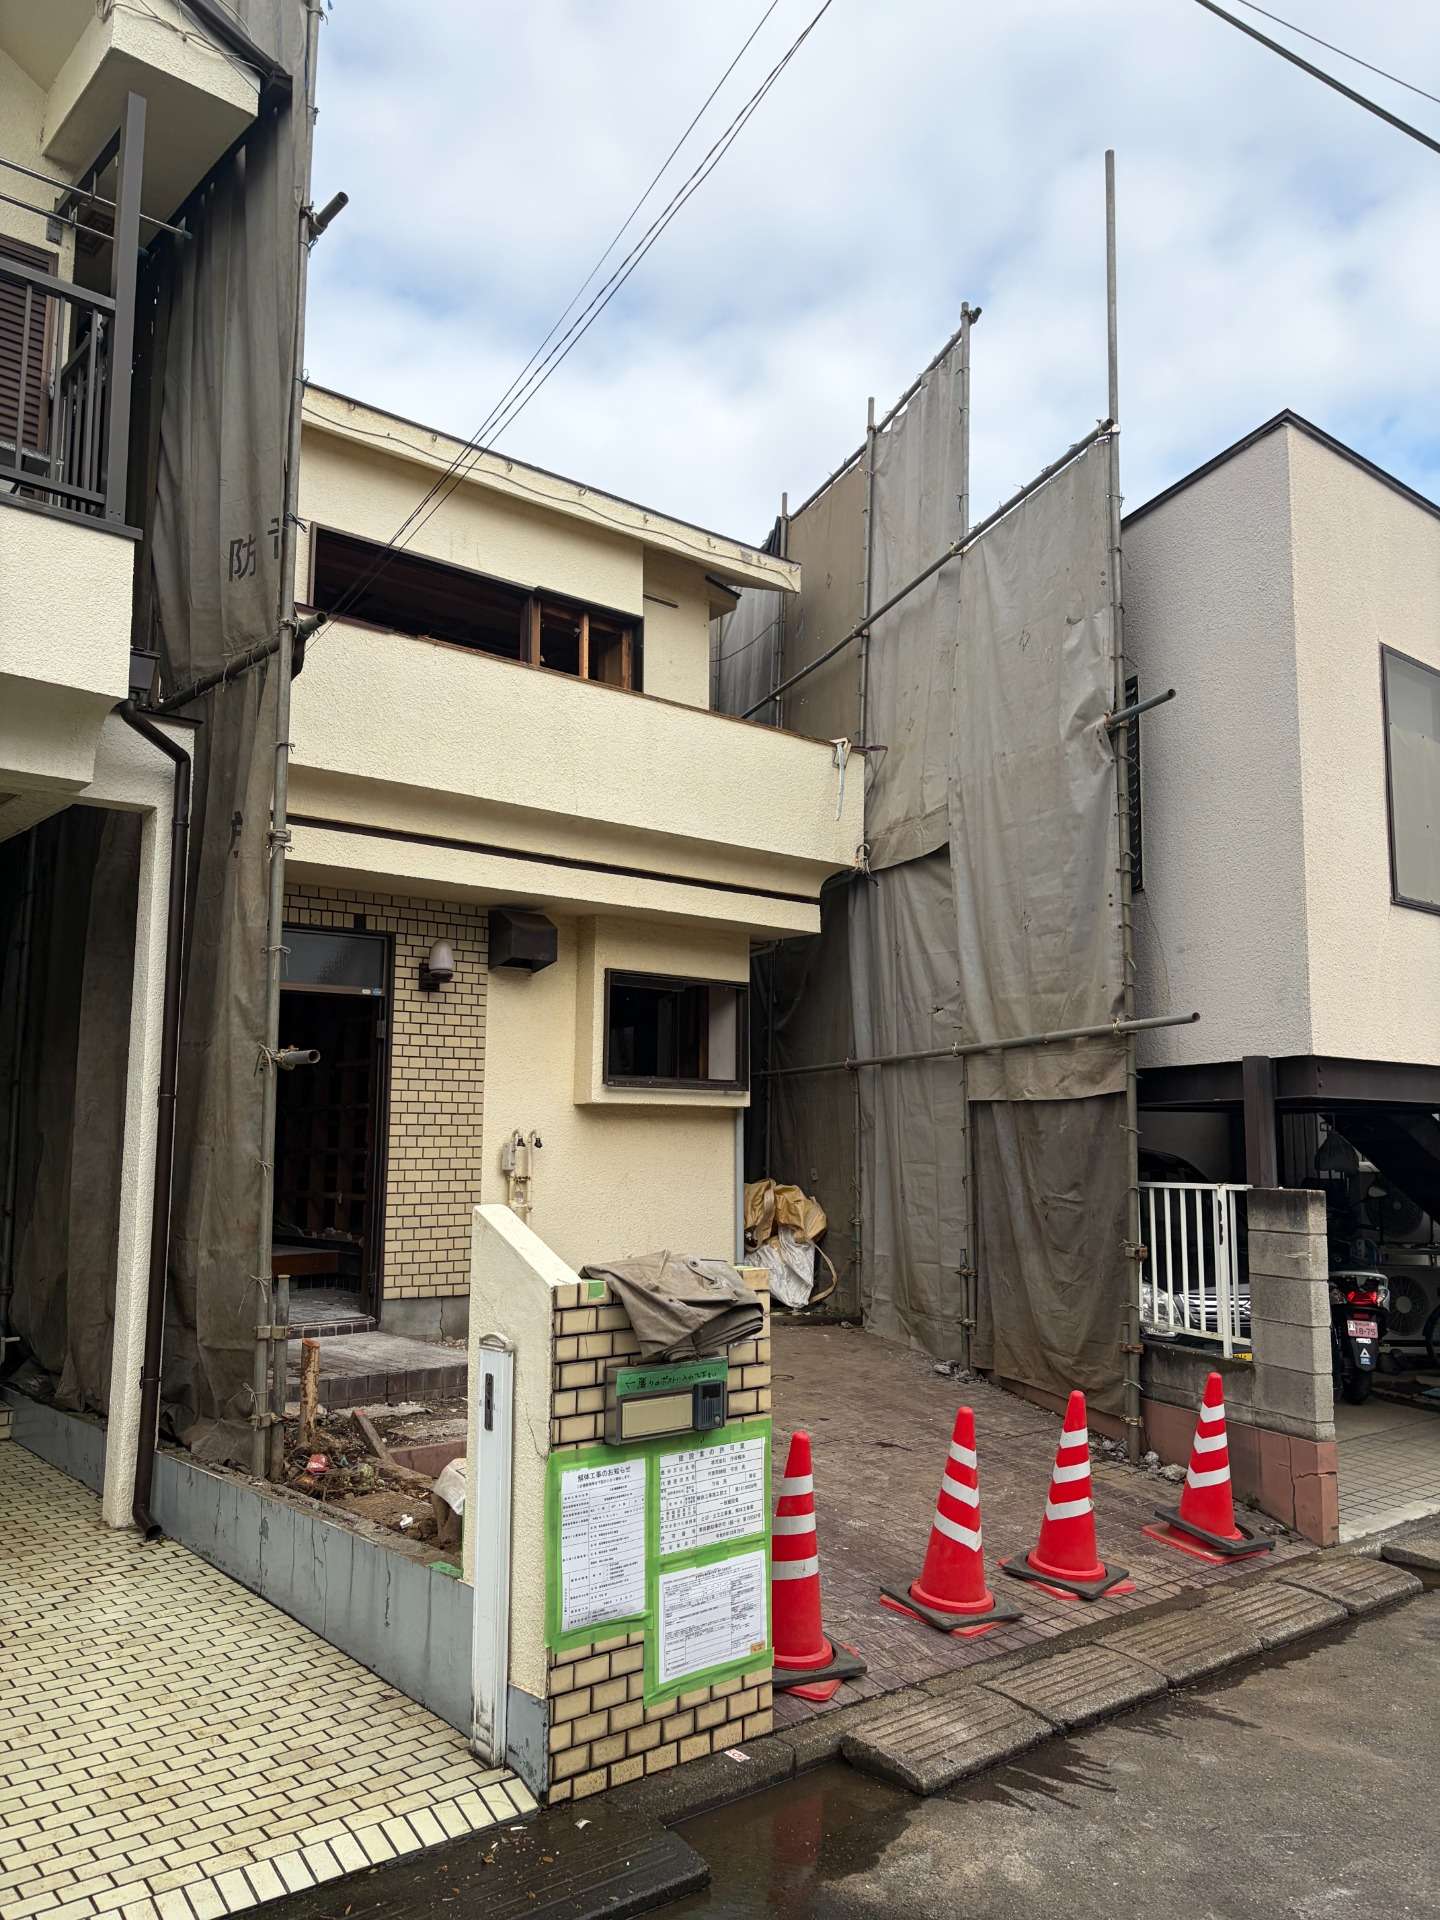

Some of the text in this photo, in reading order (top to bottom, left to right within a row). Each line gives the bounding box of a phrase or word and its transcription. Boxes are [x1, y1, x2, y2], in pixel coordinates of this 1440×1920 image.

[577, 1466, 632, 1483] 解体工事のお知らせ
